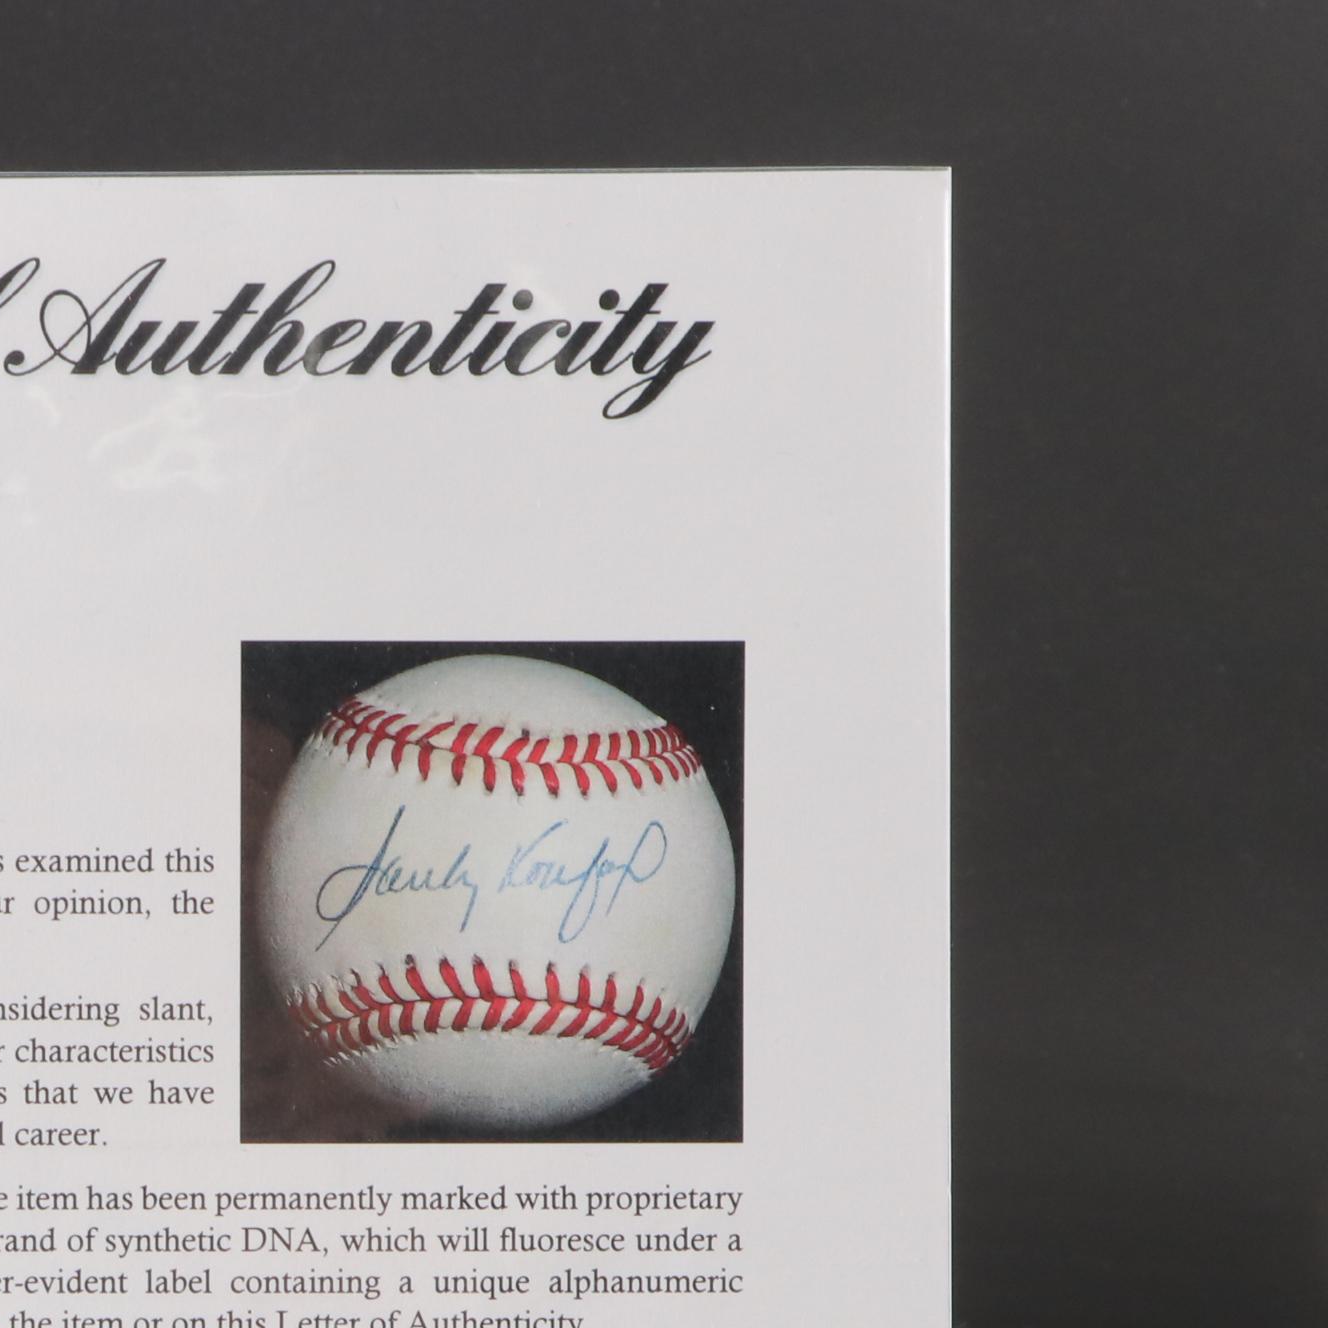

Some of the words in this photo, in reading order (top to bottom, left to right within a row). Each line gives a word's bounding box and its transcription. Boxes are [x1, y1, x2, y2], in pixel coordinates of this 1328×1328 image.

[4, 258, 714, 420] Authenticity
[14, 846, 155, 874] examined
[164, 846, 215, 874] this
[33, 888, 151, 922] opinion,
[171, 888, 215, 916] the
[138, 994, 213, 1026] slant,
[14, 1036, 215, 1064] characteristics
[14, 1127, 108, 1147] career.
[16, 1184, 80, 1211] item
[85, 1184, 134, 1211] has
[139, 1184, 208, 1211] been
[214, 1184, 393, 1217] permanently
[400, 1184, 509, 1211] marked
[514, 1184, 579, 1211] with
[585, 1183, 744, 1217] proprietary
[66, 1226, 100, 1253] of
[104, 1226, 232, 1259] synthetic
[240, 1226, 329, 1257] DNA,
[339, 1226, 427, 1253] which
[436, 1226, 490, 1253] will
[499, 1226, 626, 1253] fluoresce
[634, 1226, 718, 1253] under
[727, 1233, 744, 1252] a
[145, 1268, 213, 1295] label
[230, 1267, 382, 1301] containing
[398, 1275, 415, 1295] a
[433, 1267, 531, 1301] unique
[548, 1267, 744, 1301] alphanumeric
